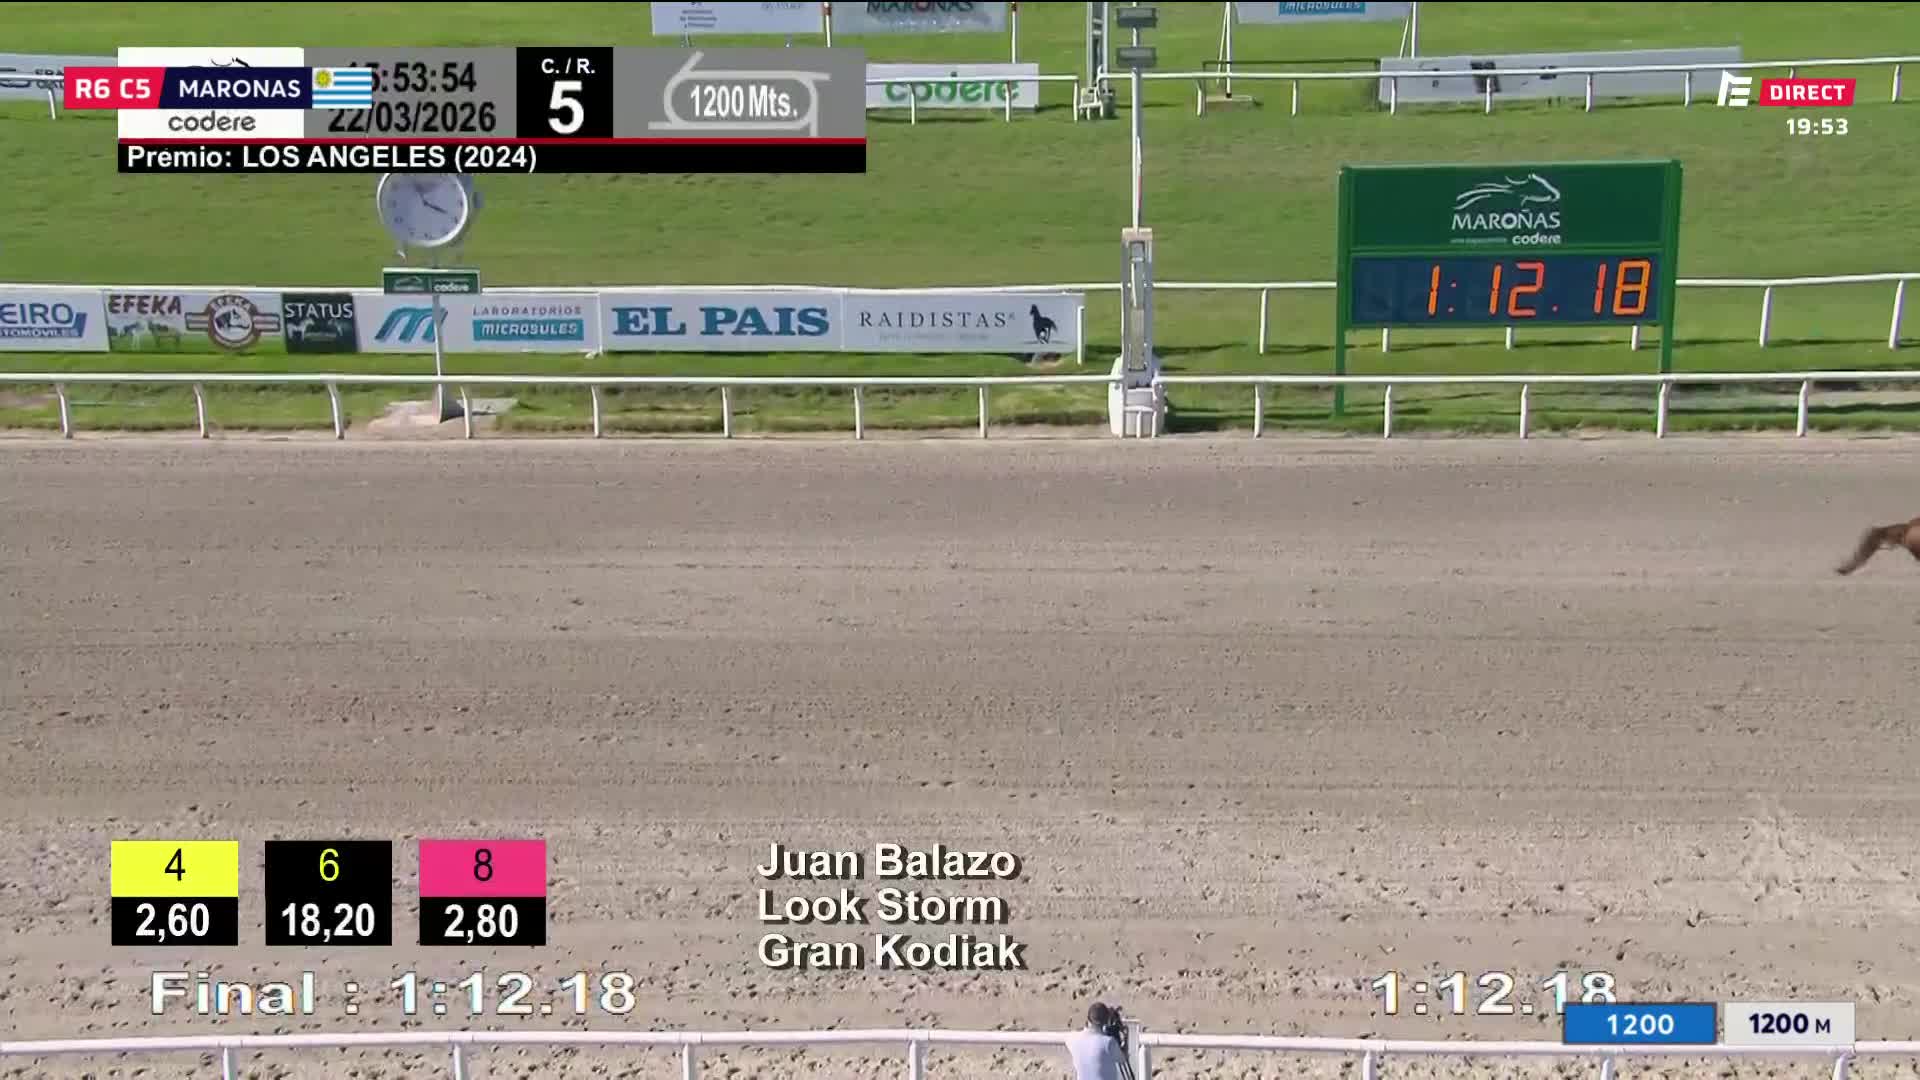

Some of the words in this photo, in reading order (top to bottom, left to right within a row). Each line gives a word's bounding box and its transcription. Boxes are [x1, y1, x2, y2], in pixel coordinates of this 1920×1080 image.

[1451, 209, 1561, 230] MAROÑAS
[1512, 232, 1561, 245] codere
[108, 295, 183, 315] EFEKA
[284, 303, 353, 318] STATUS
[473, 305, 583, 317] LABORATORIOS
[611, 307, 687, 336] EL
[699, 307, 830, 336] PAIS
[860, 311, 1006, 328] RAIDISTAS
[481, 323, 577, 336] MICROSULES
